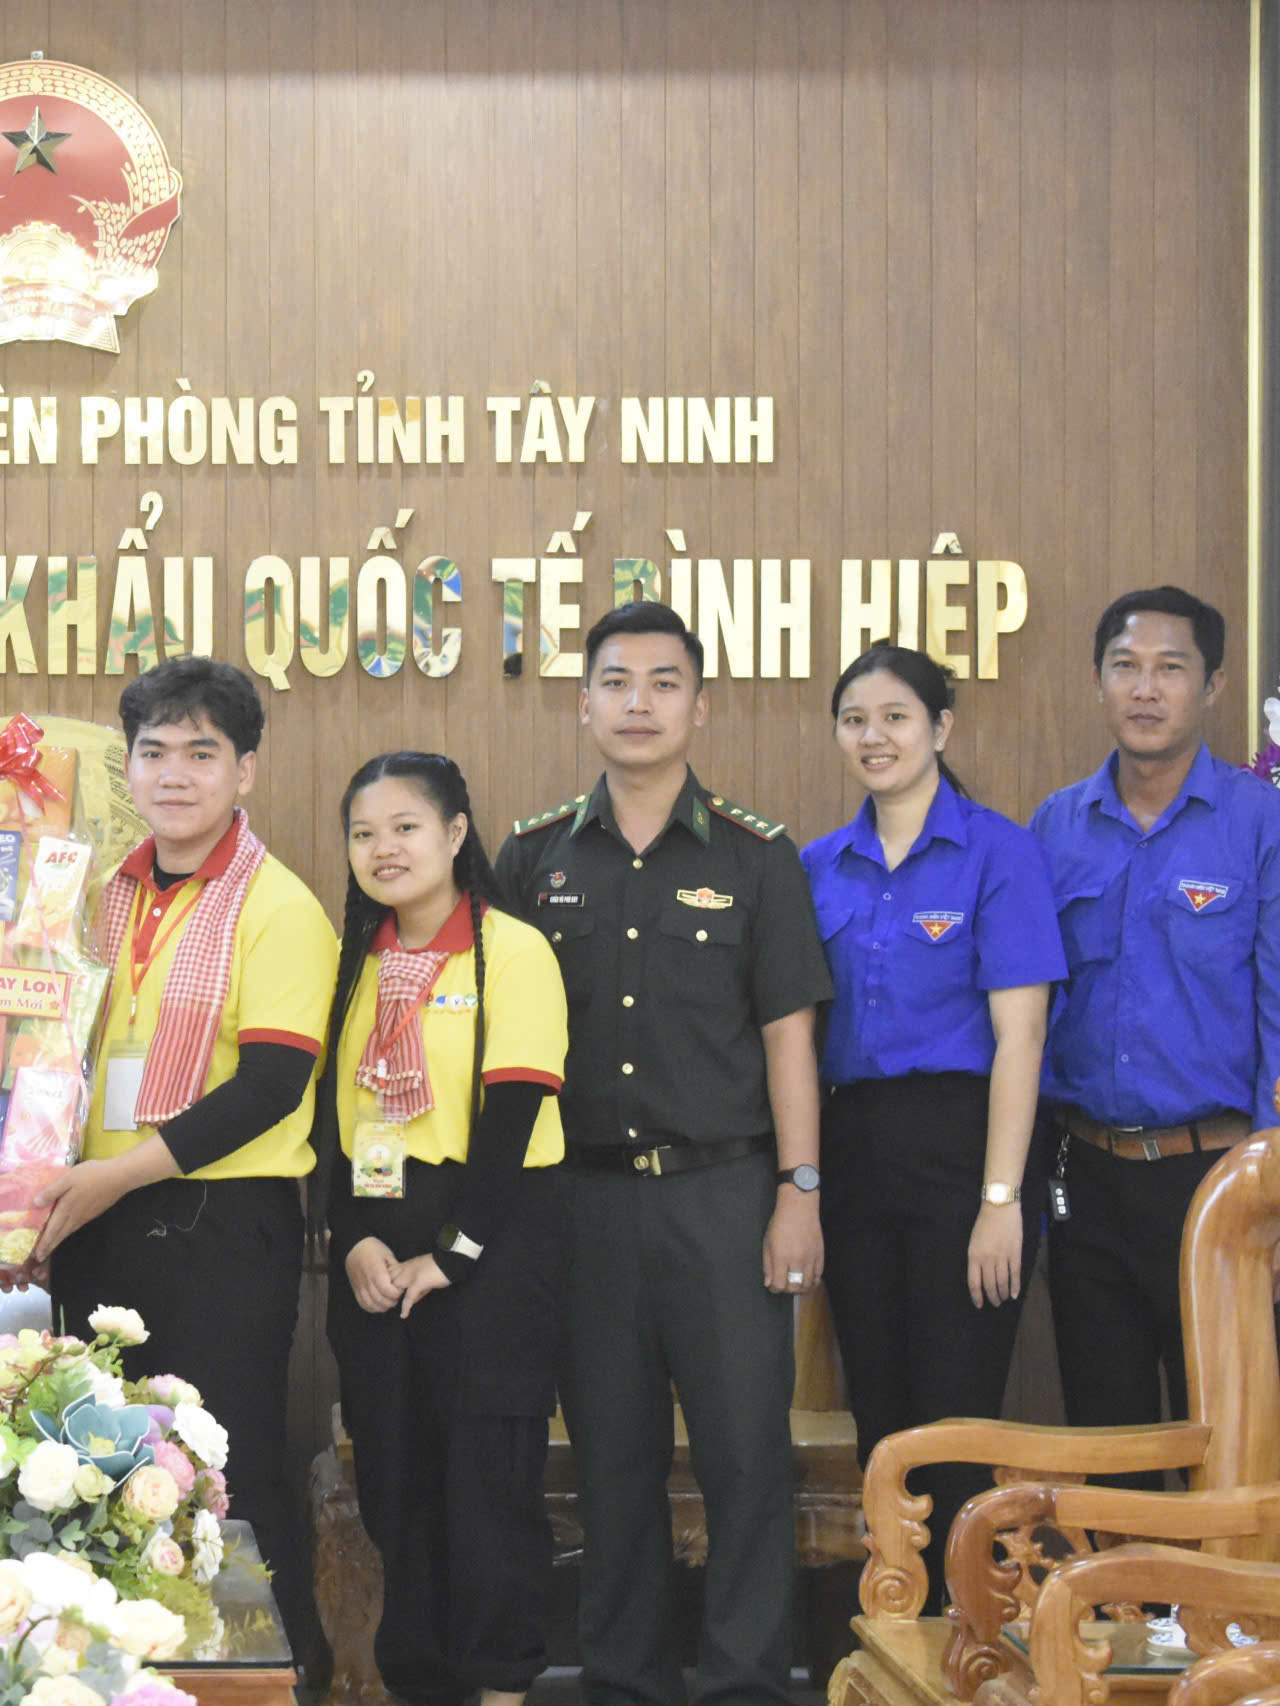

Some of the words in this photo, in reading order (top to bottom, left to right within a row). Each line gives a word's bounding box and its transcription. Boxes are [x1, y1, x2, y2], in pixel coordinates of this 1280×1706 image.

[81, 377, 298, 466] PHÒNG
[320, 369, 465, 464] TỈNH
[486, 379, 596, 464] TÂY
[621, 396, 774, 464] NINH
[244, 508, 463, 691] QUỐC
[491, 511, 593, 678] TẾ
[44, 851, 78, 865] AFC
